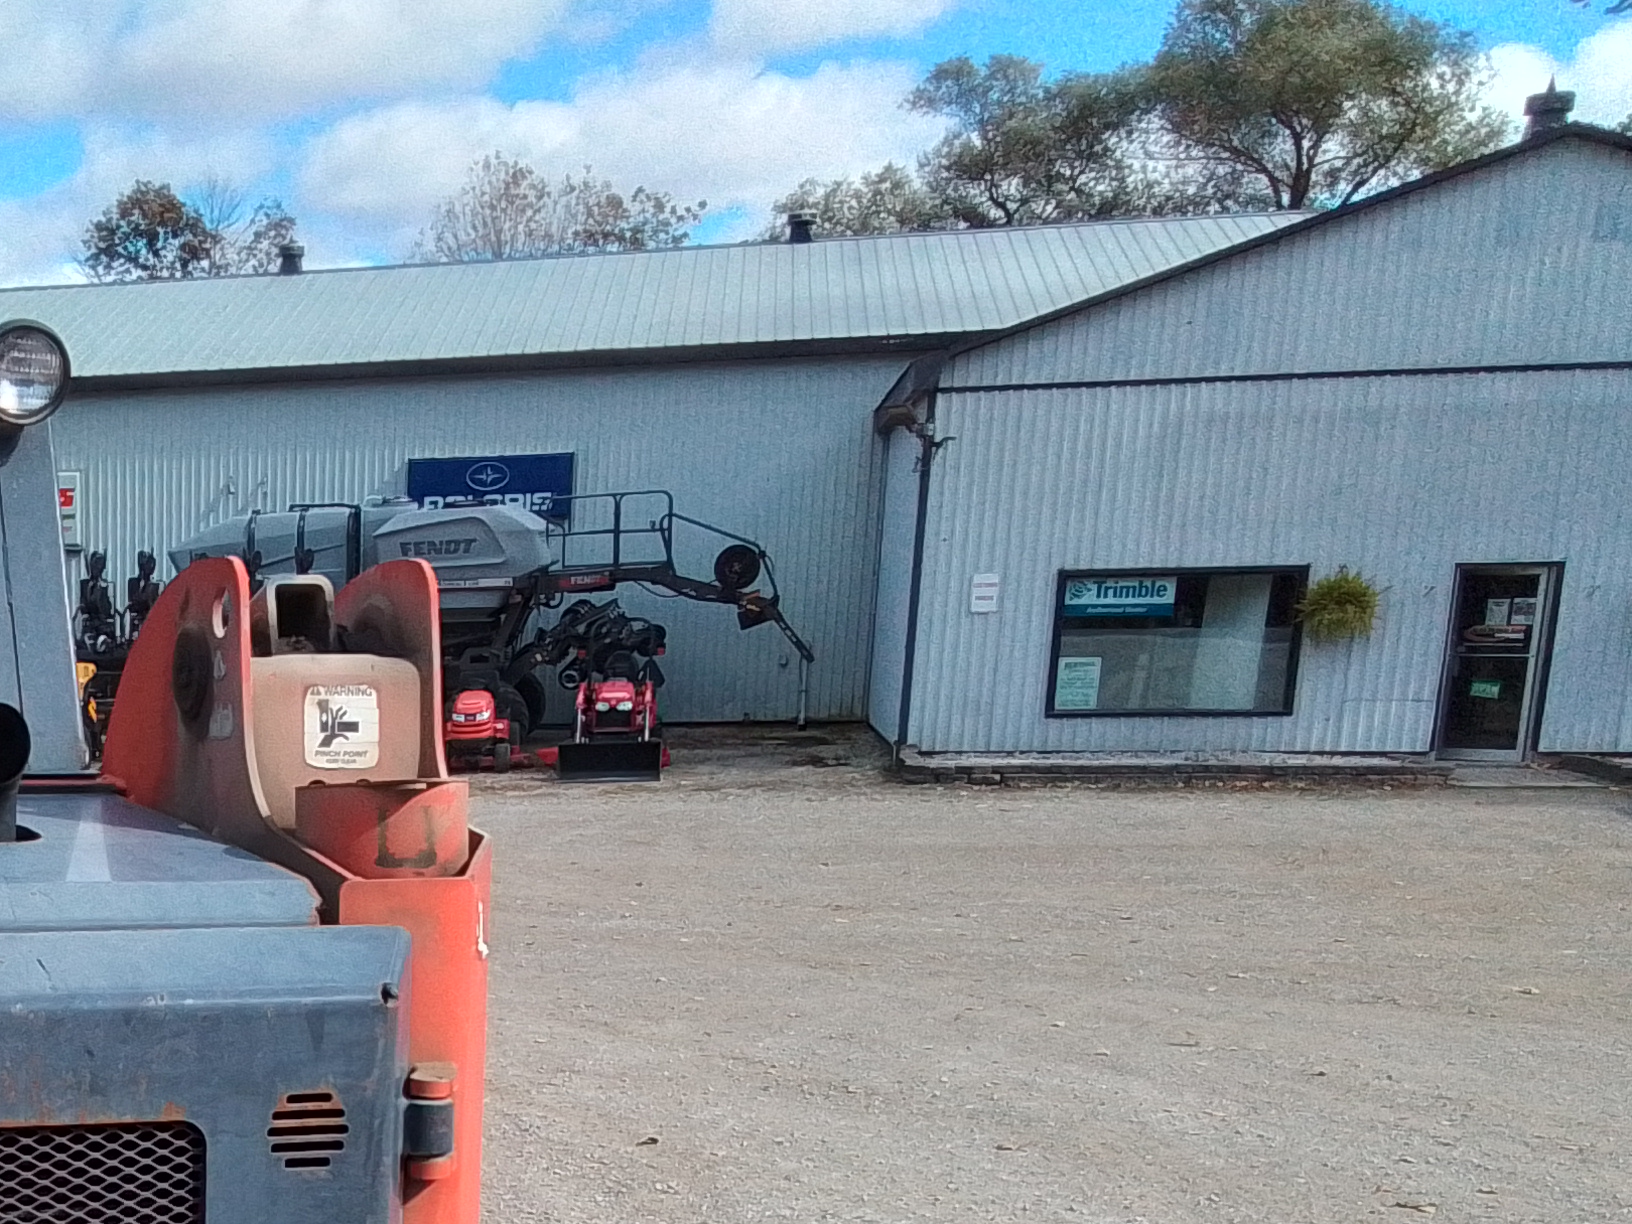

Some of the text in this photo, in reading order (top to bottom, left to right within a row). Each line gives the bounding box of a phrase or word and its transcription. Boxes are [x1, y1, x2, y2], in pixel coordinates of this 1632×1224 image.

[399, 538, 478, 557] FENDT
[1092, 580, 1169, 599] Trimble
[324, 685, 373, 697] WARNING
[314, 749, 369, 758] PINCH POINT
